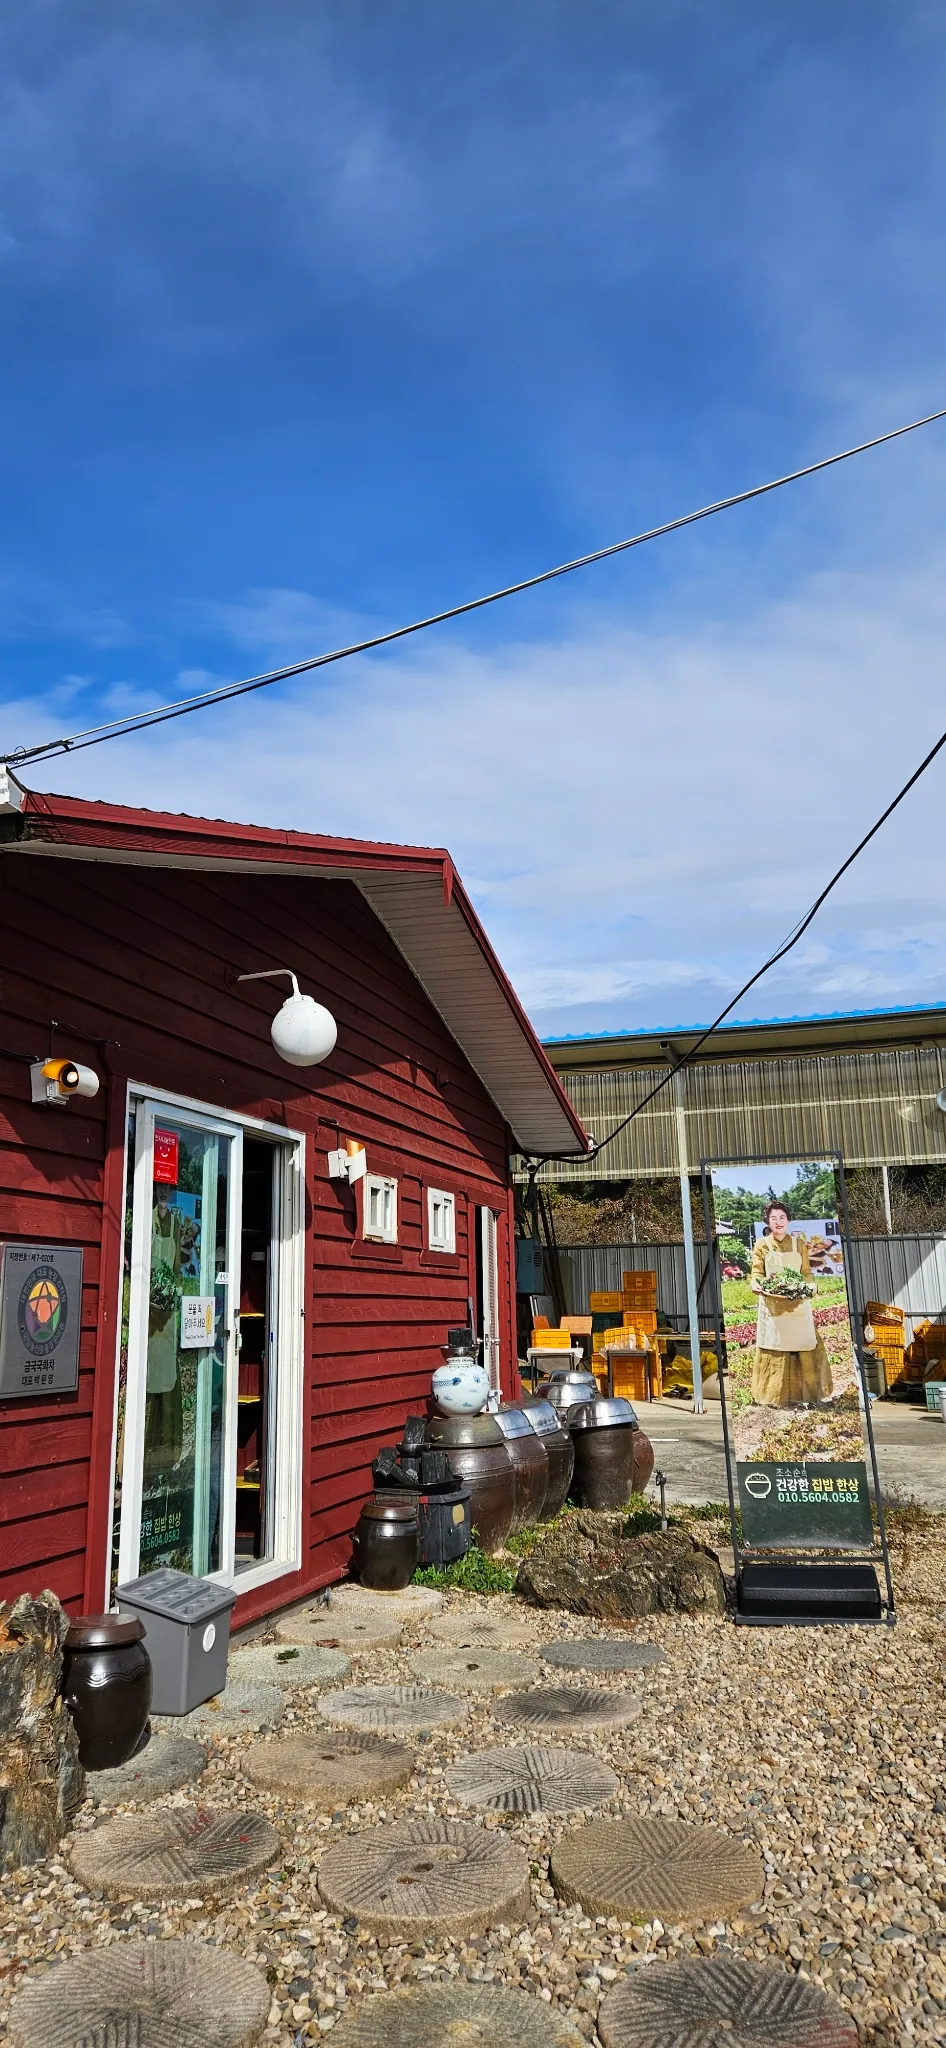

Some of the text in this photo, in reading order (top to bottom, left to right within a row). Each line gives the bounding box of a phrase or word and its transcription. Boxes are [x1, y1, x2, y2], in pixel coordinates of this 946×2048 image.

[188, 1303, 197, 1315] 문을
[776, 1478, 860, 1492] 건강한 집밥 한상
[778, 1492, 860, 1503] 010.5604.0582
[140, 1511, 182, 1538] 강한 집밥 한상
[140, 1528, 181, 1552] 0.5604.0582
